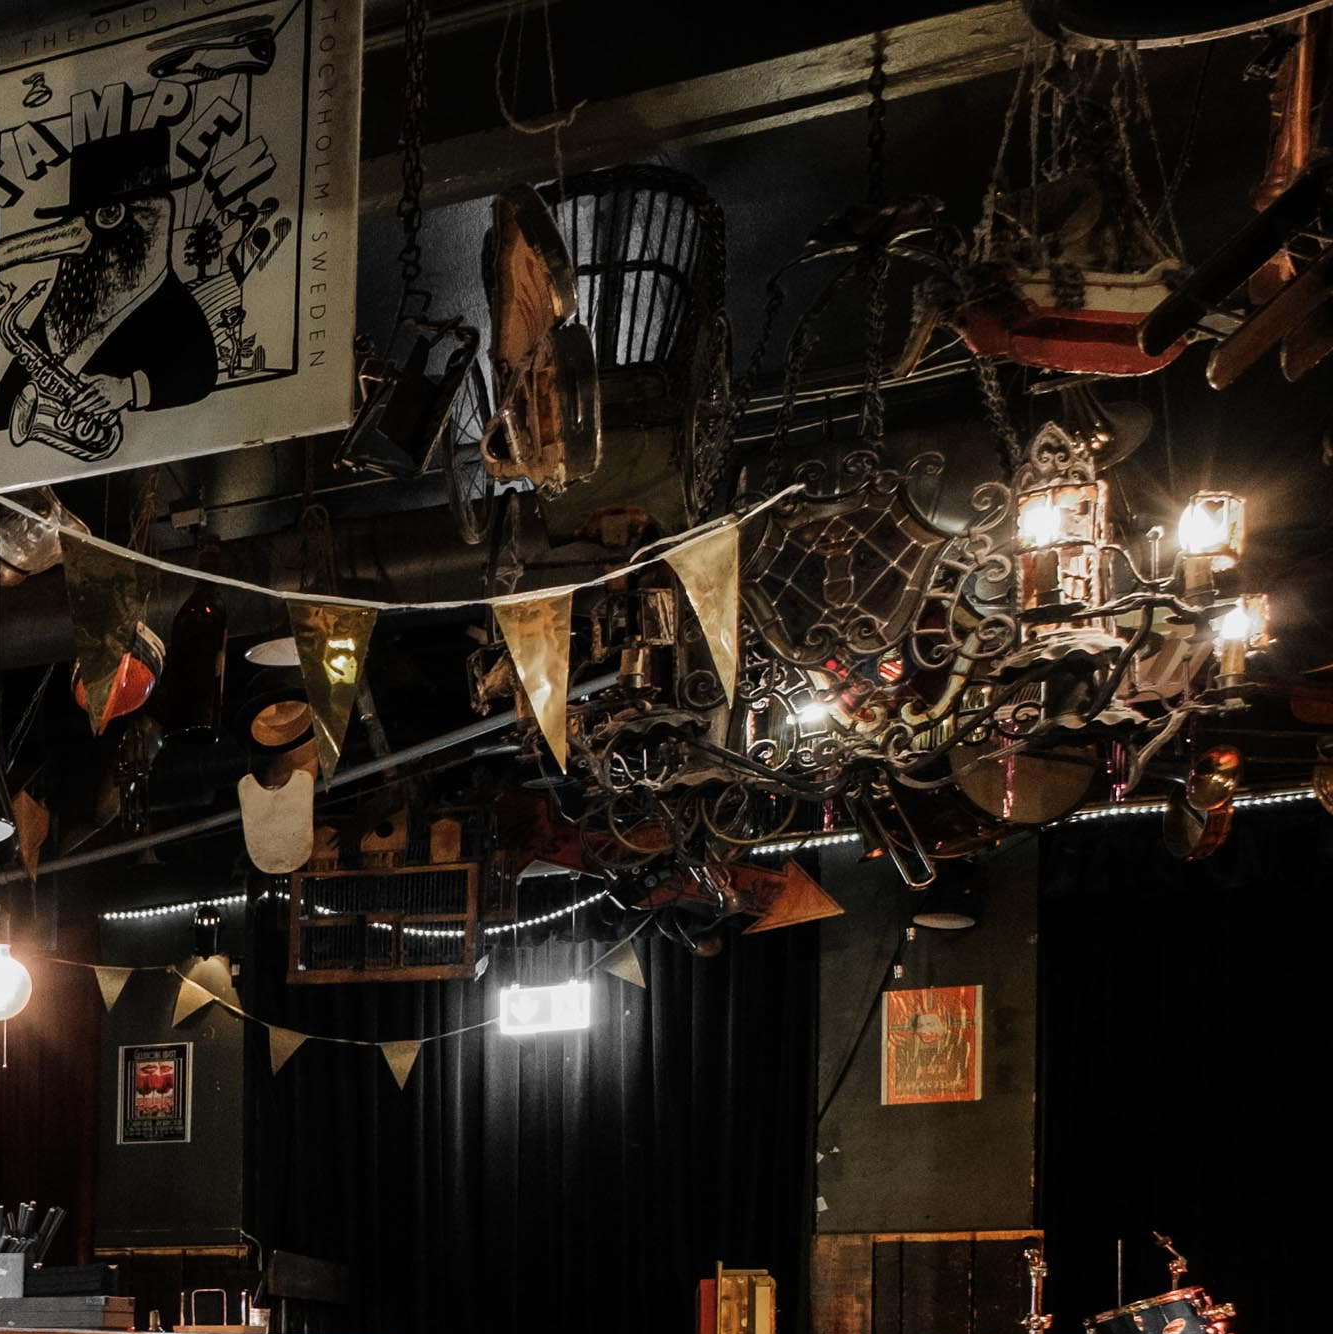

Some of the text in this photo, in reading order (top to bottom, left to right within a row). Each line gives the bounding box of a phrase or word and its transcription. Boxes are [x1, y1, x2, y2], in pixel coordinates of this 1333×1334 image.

[21, 31, 80, 54] THE
[94, 7, 158, 35] OLD
[308, 11, 337, 368] TOCKHOLM SWEDEN
